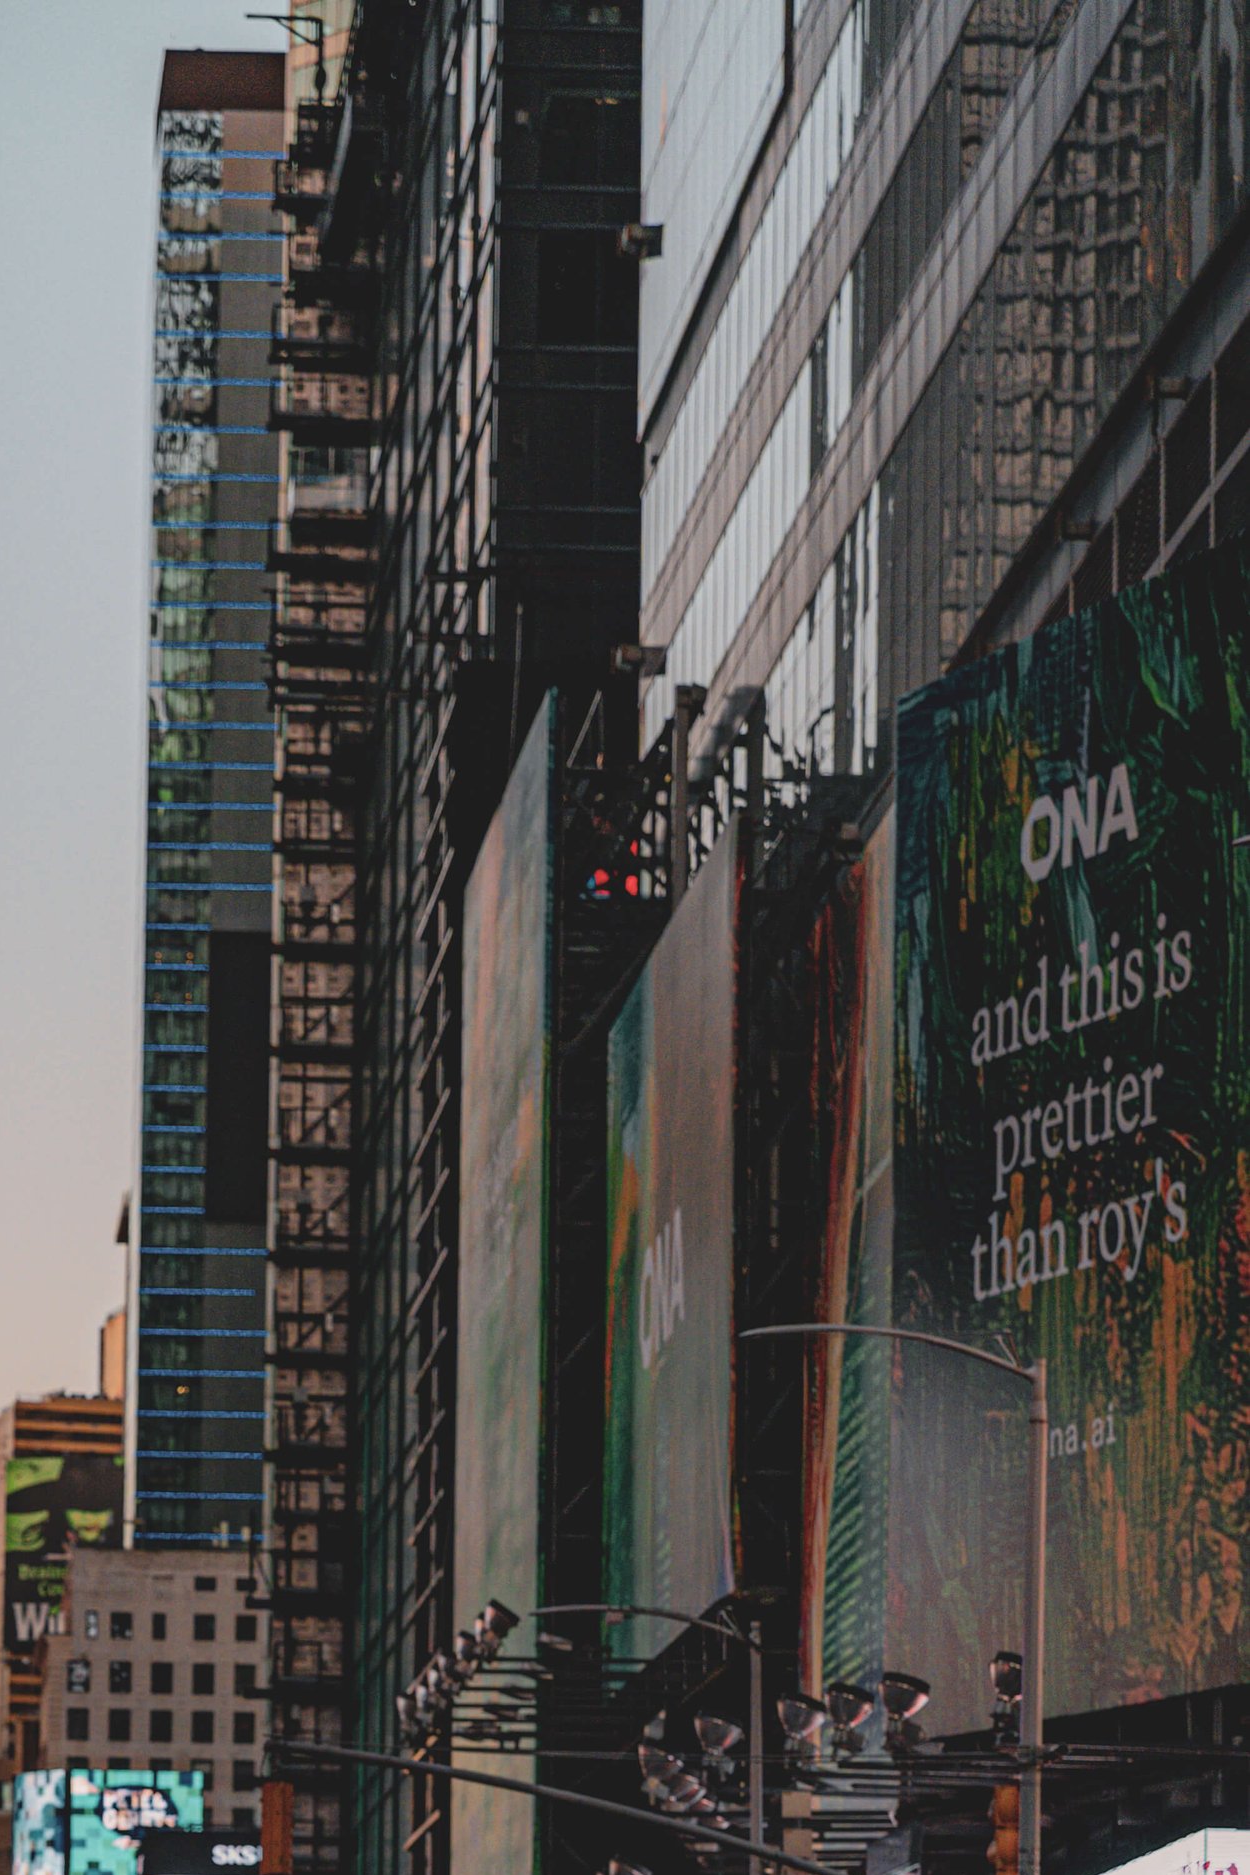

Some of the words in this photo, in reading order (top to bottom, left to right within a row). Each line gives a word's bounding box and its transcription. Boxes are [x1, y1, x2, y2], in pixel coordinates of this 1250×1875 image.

[1020, 762, 1140, 884] ONA
[971, 960, 1051, 1067] and
[1059, 931, 1146, 1032] this
[1153, 912, 1194, 1001] is
[993, 1055, 1165, 1201] prettier
[639, 1206, 686, 1370] ONA
[971, 1206, 1069, 1303] than
[1076, 1158, 1190, 1282] roy's
[1049, 1401, 1117, 1458] na.ai
